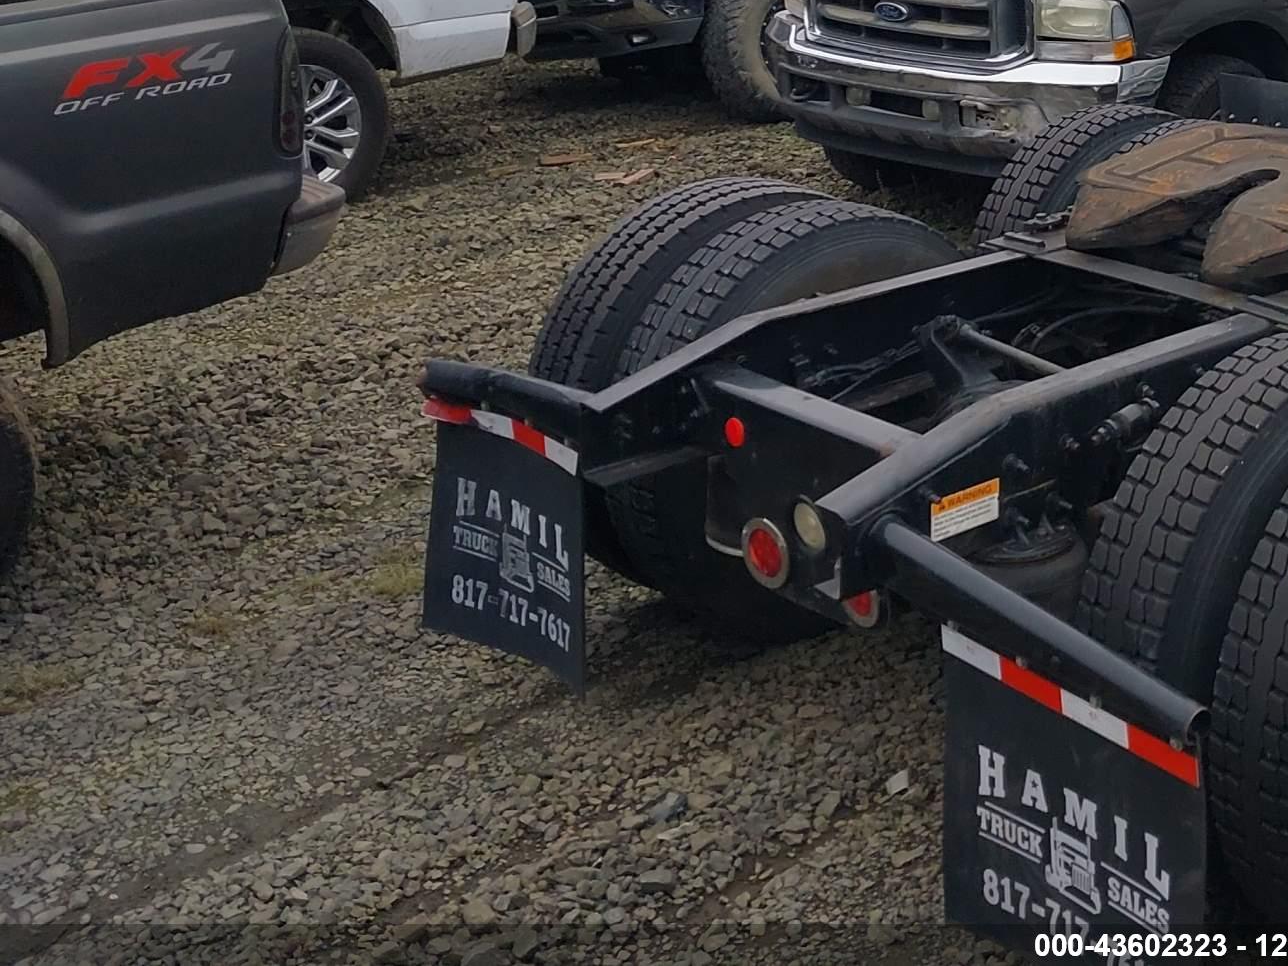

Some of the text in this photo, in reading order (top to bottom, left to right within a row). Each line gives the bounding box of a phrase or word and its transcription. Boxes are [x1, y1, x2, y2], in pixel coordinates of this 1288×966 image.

[54, 73, 233, 116] OFF ROAD
[63, 41, 236, 99] FX4
[453, 525, 571, 597] TRUCK SALES
[456, 477, 570, 573] HAMIL
[452, 574, 571, 653] 817-717-7617
[978, 744, 1170, 902] HAMIL
[977, 806, 1170, 934] TRUCK SALES
